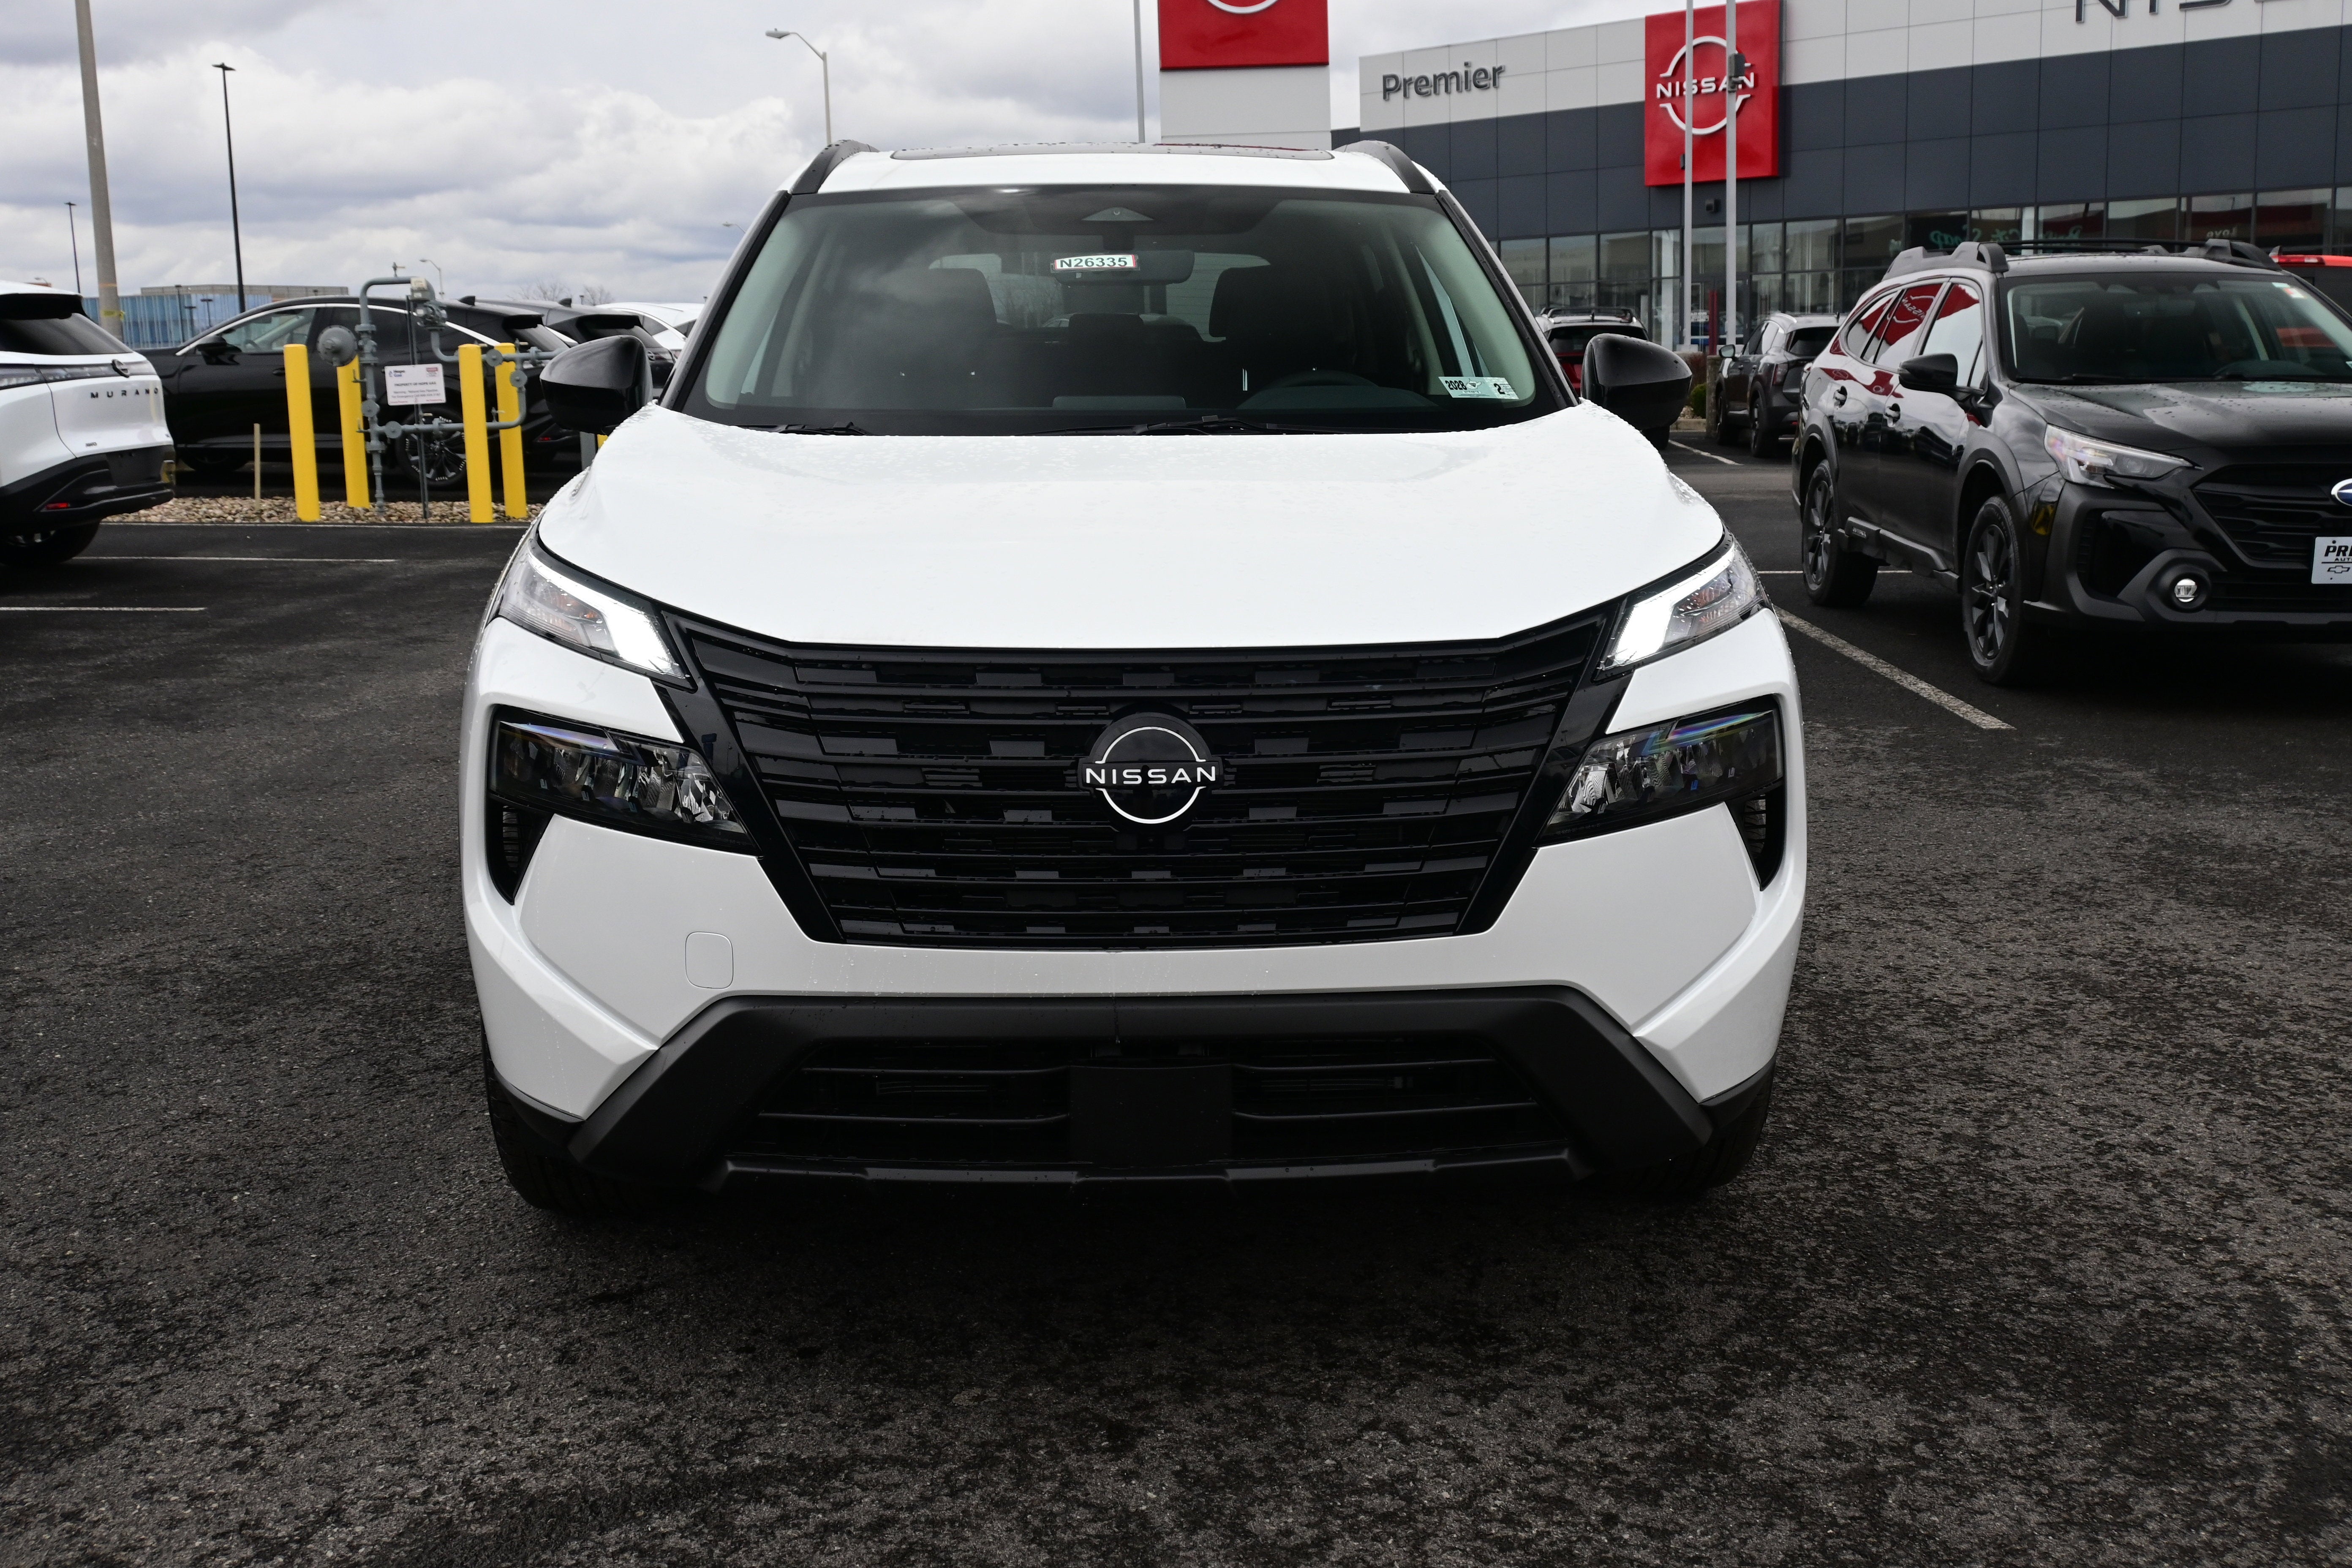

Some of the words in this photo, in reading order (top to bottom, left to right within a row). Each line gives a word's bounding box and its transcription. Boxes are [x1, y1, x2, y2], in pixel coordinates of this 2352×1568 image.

[1382, 61, 1506, 101] Premier
[1060, 257, 1127, 268] N26335
[1445, 380, 1467, 390] 2028
[1494, 383, 1506, 395] 2
[90, 387, 158, 398] MURANO
[1086, 766, 1216, 784] NISSAN
